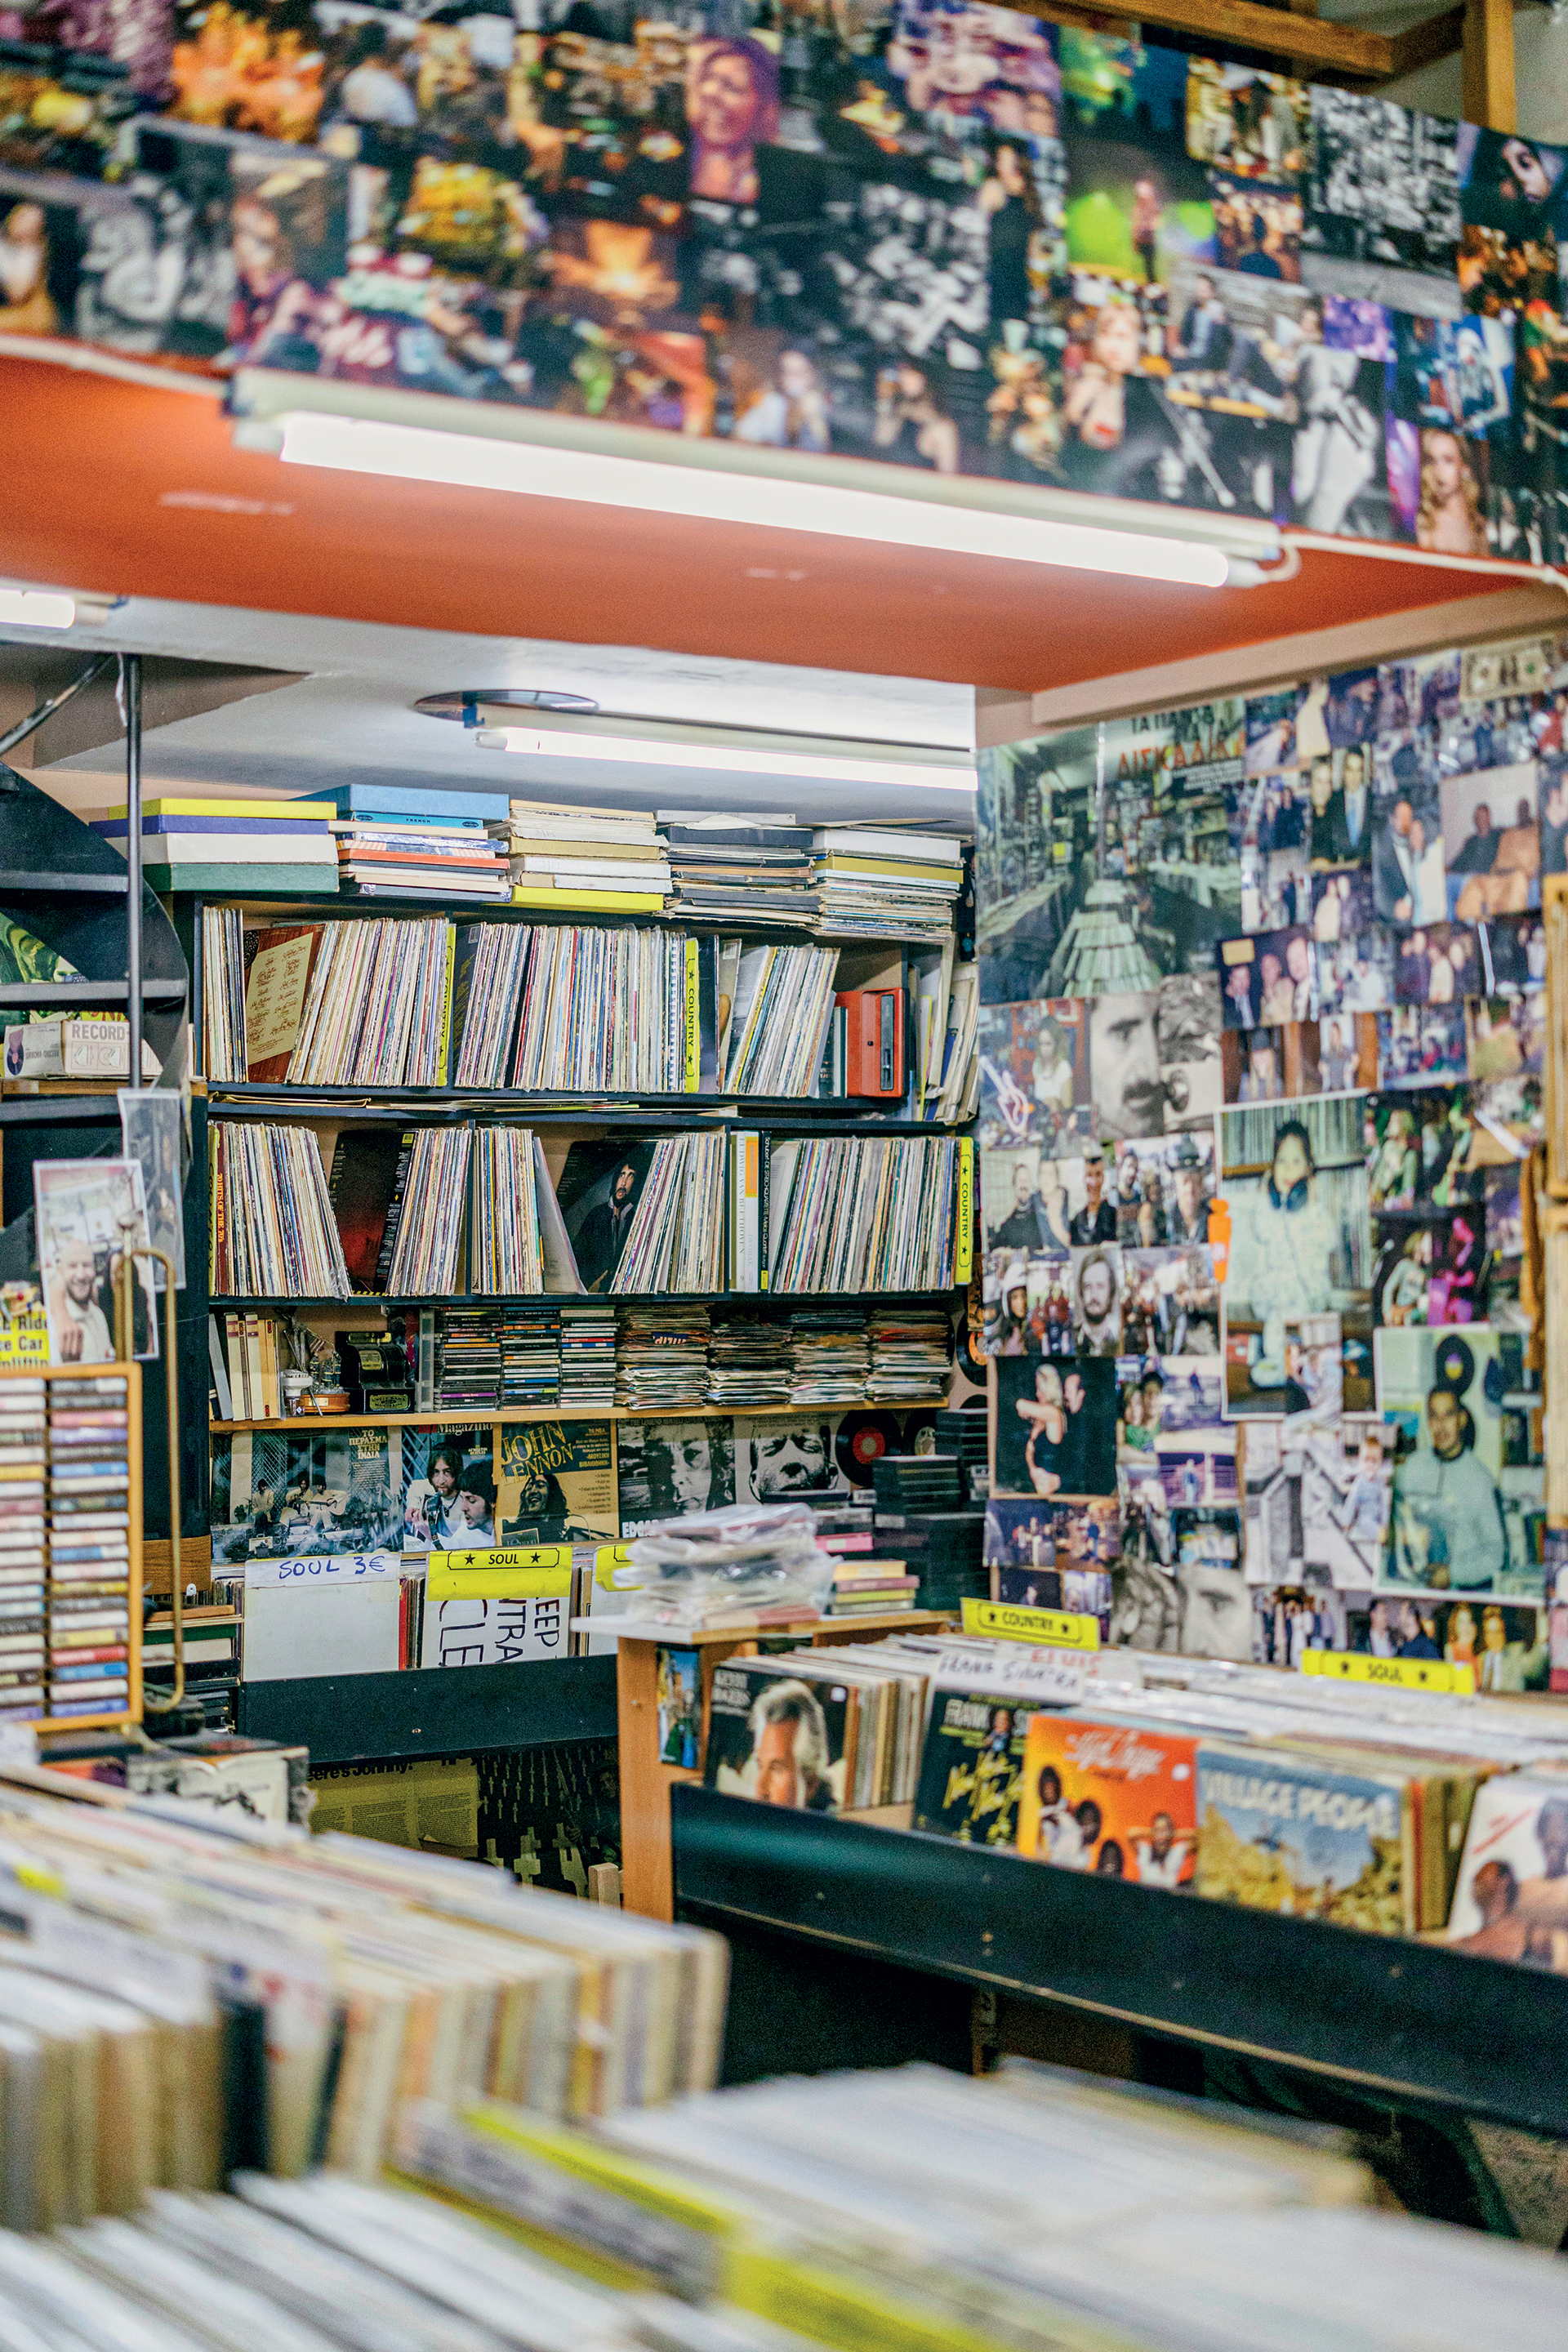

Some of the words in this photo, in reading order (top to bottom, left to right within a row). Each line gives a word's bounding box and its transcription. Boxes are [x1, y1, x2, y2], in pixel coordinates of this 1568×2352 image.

[687, 988, 695, 1047] COUNTRY
[217, 1173, 223, 1182] 70
[217, 1200, 224, 1212] OF
[18, 1312, 47, 1331] Rid
[18, 1334, 42, 1352] Car
[349, 1436, 388, 1446] ΠΕΡΑΣΜΑ
[357, 1444, 381, 1453] ΣΤΗΝ
[501, 1421, 566, 1465] JOHN
[358, 1451, 381, 1459] ΙΝΔΙΑ
[278, 1558, 340, 1579] SOUL
[354, 1555, 385, 1575] 3€
[488, 1553, 519, 1565] SOUL
[534, 1597, 559, 1648] EEP
[1367, 1662, 1404, 1683] SOUL
